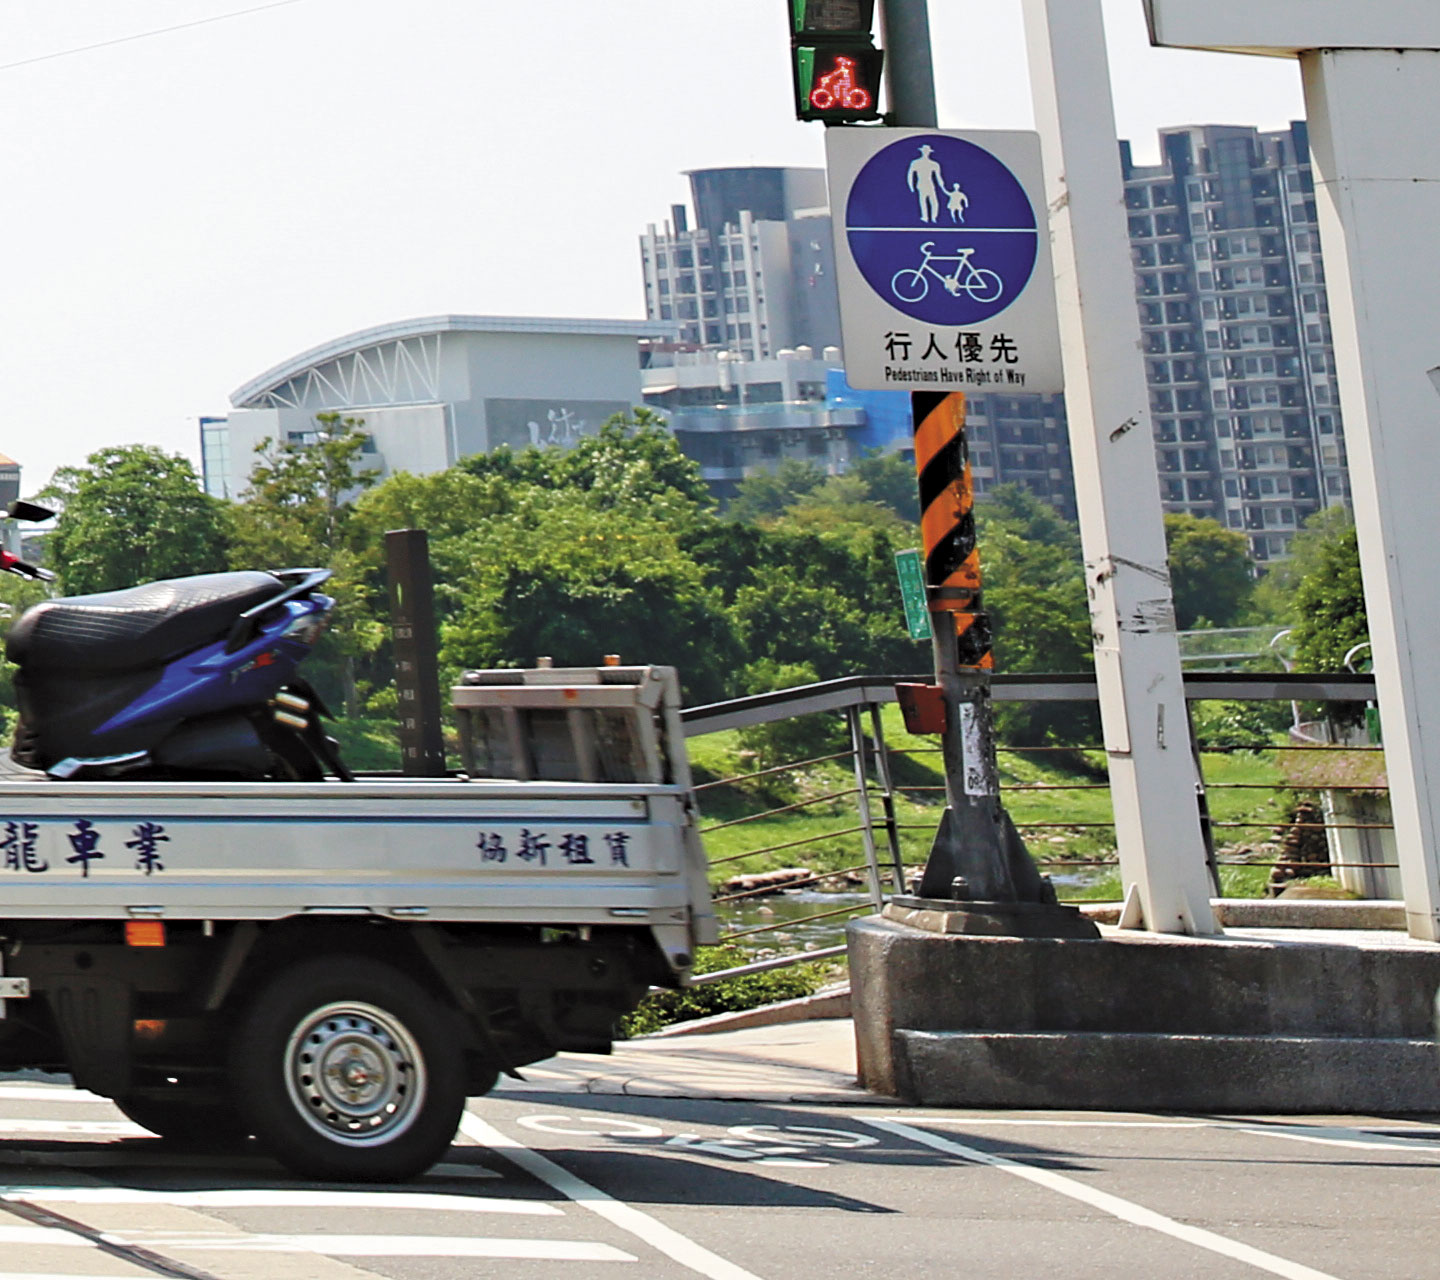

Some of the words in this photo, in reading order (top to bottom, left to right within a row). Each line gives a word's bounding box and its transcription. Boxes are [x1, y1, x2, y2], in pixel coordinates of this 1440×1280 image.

[884, 331, 1019, 364] 行人優先
[885, 366, 938, 383] Pedestrians
[940, 368, 964, 383] Have
[966, 368, 991, 386] Right
[993, 369, 1004, 384] of
[1005, 370, 1026, 387] Way
[476, 827, 631, 869] 協新租賃
